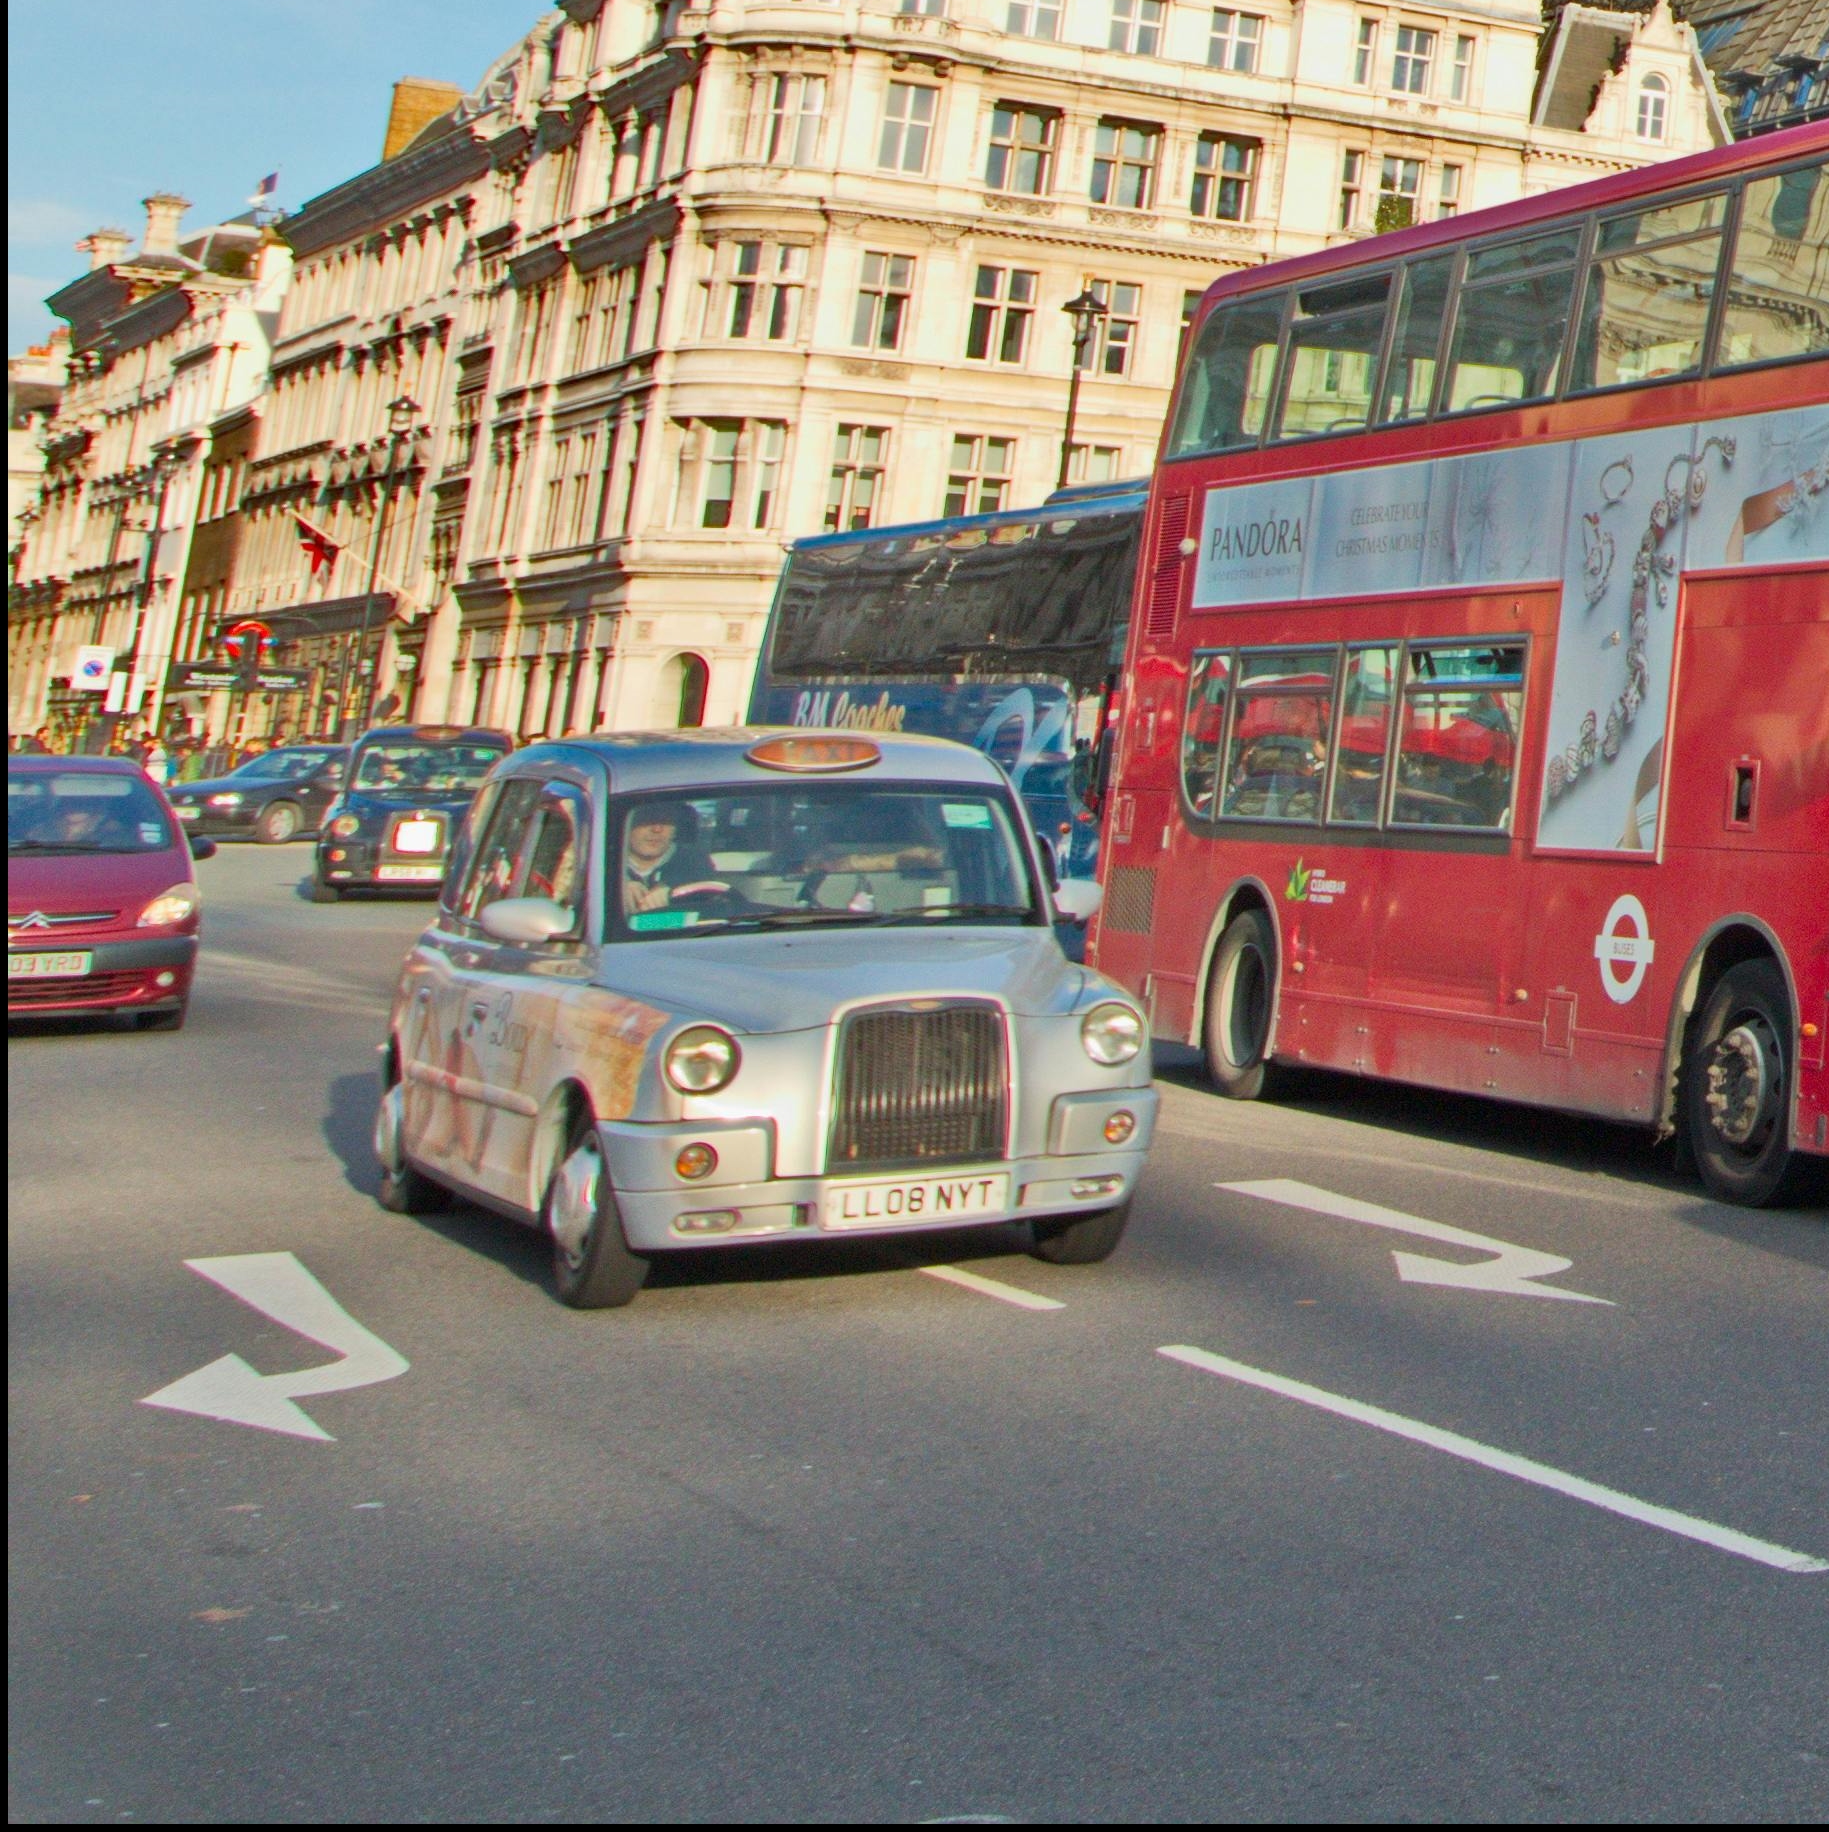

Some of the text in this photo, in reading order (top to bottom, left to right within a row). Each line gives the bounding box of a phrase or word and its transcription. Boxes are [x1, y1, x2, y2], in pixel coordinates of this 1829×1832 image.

[1210, 519, 1302, 561] PANDORA
[843, 1180, 994, 1218] LL08 NYT
